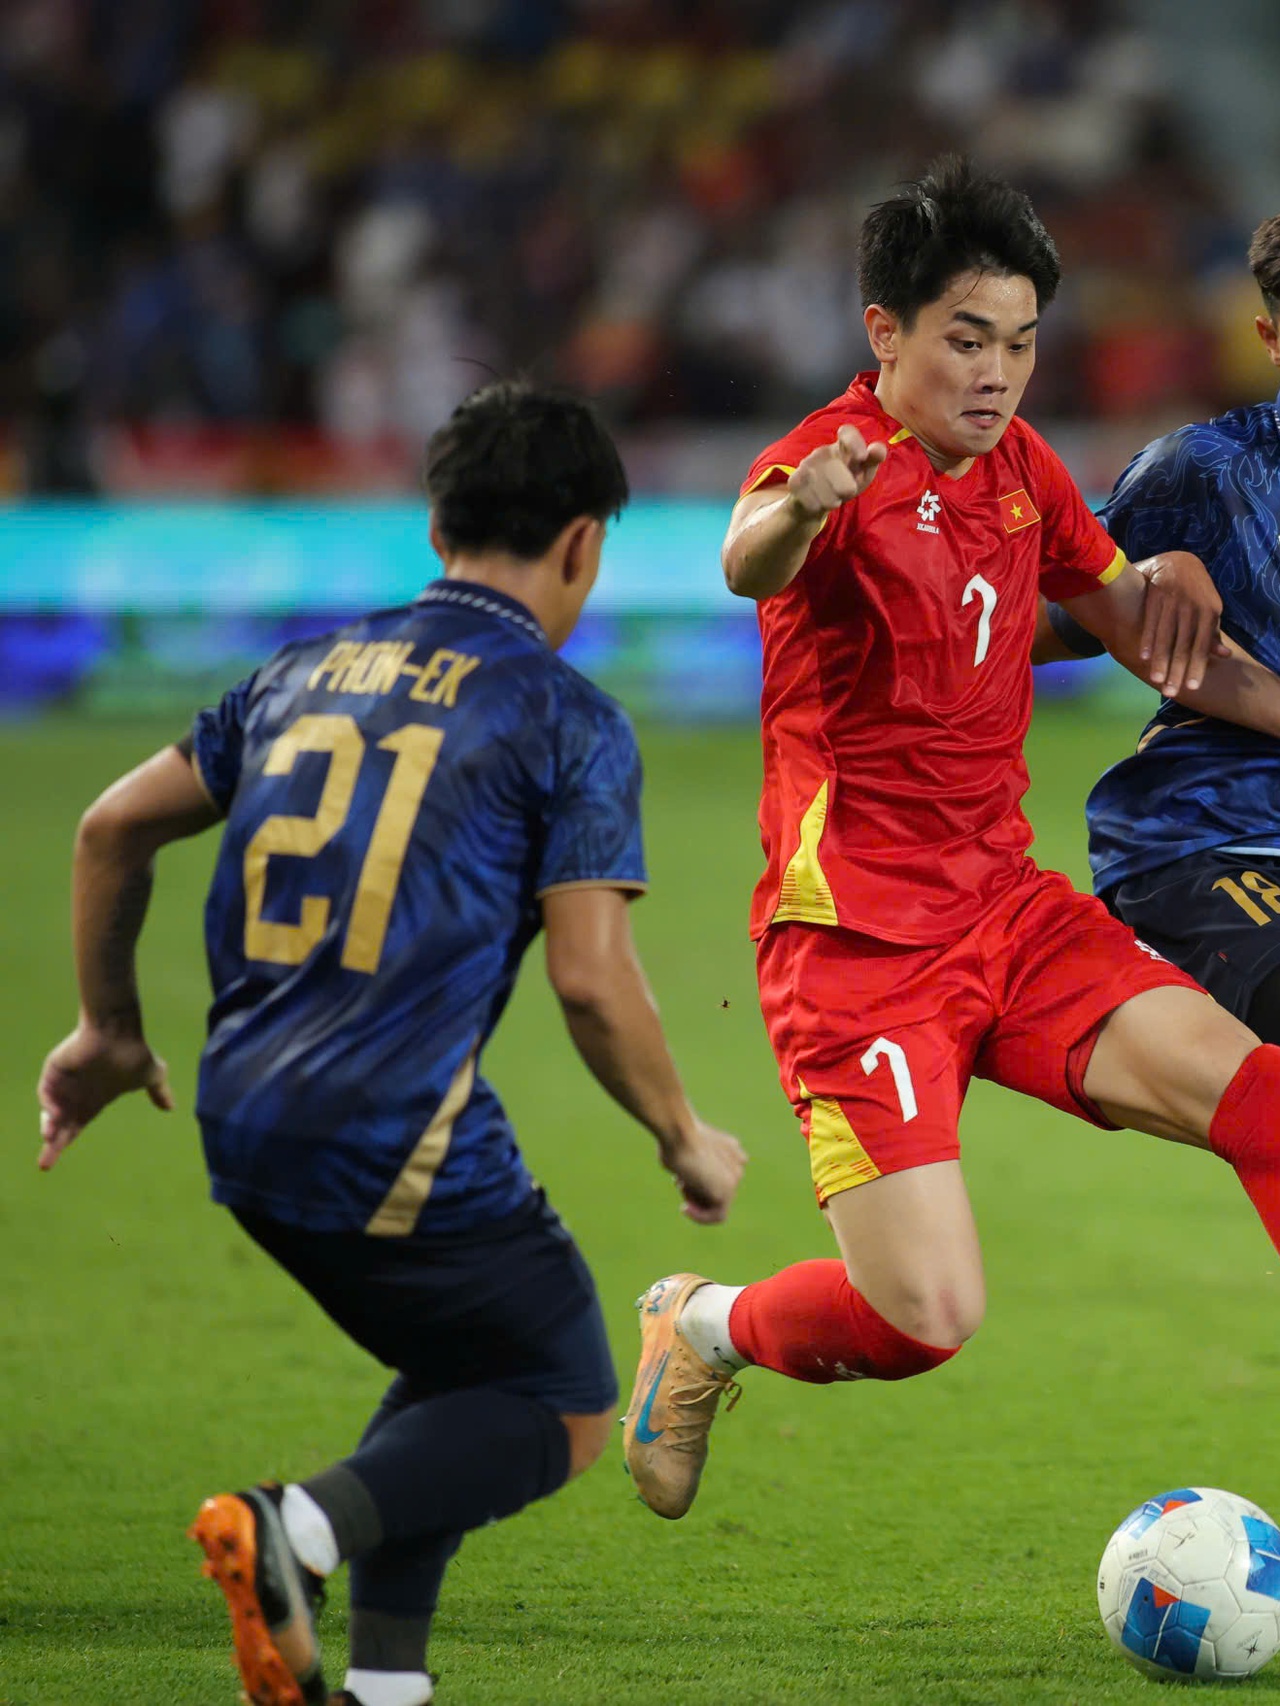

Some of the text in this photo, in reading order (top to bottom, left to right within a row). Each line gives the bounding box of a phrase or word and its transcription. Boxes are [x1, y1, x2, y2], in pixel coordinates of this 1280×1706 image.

[961, 573, 998, 668] 7
[307, 640, 482, 708] PHON-EK
[243, 713, 445, 975] 21
[859, 1036, 918, 1123] 7
